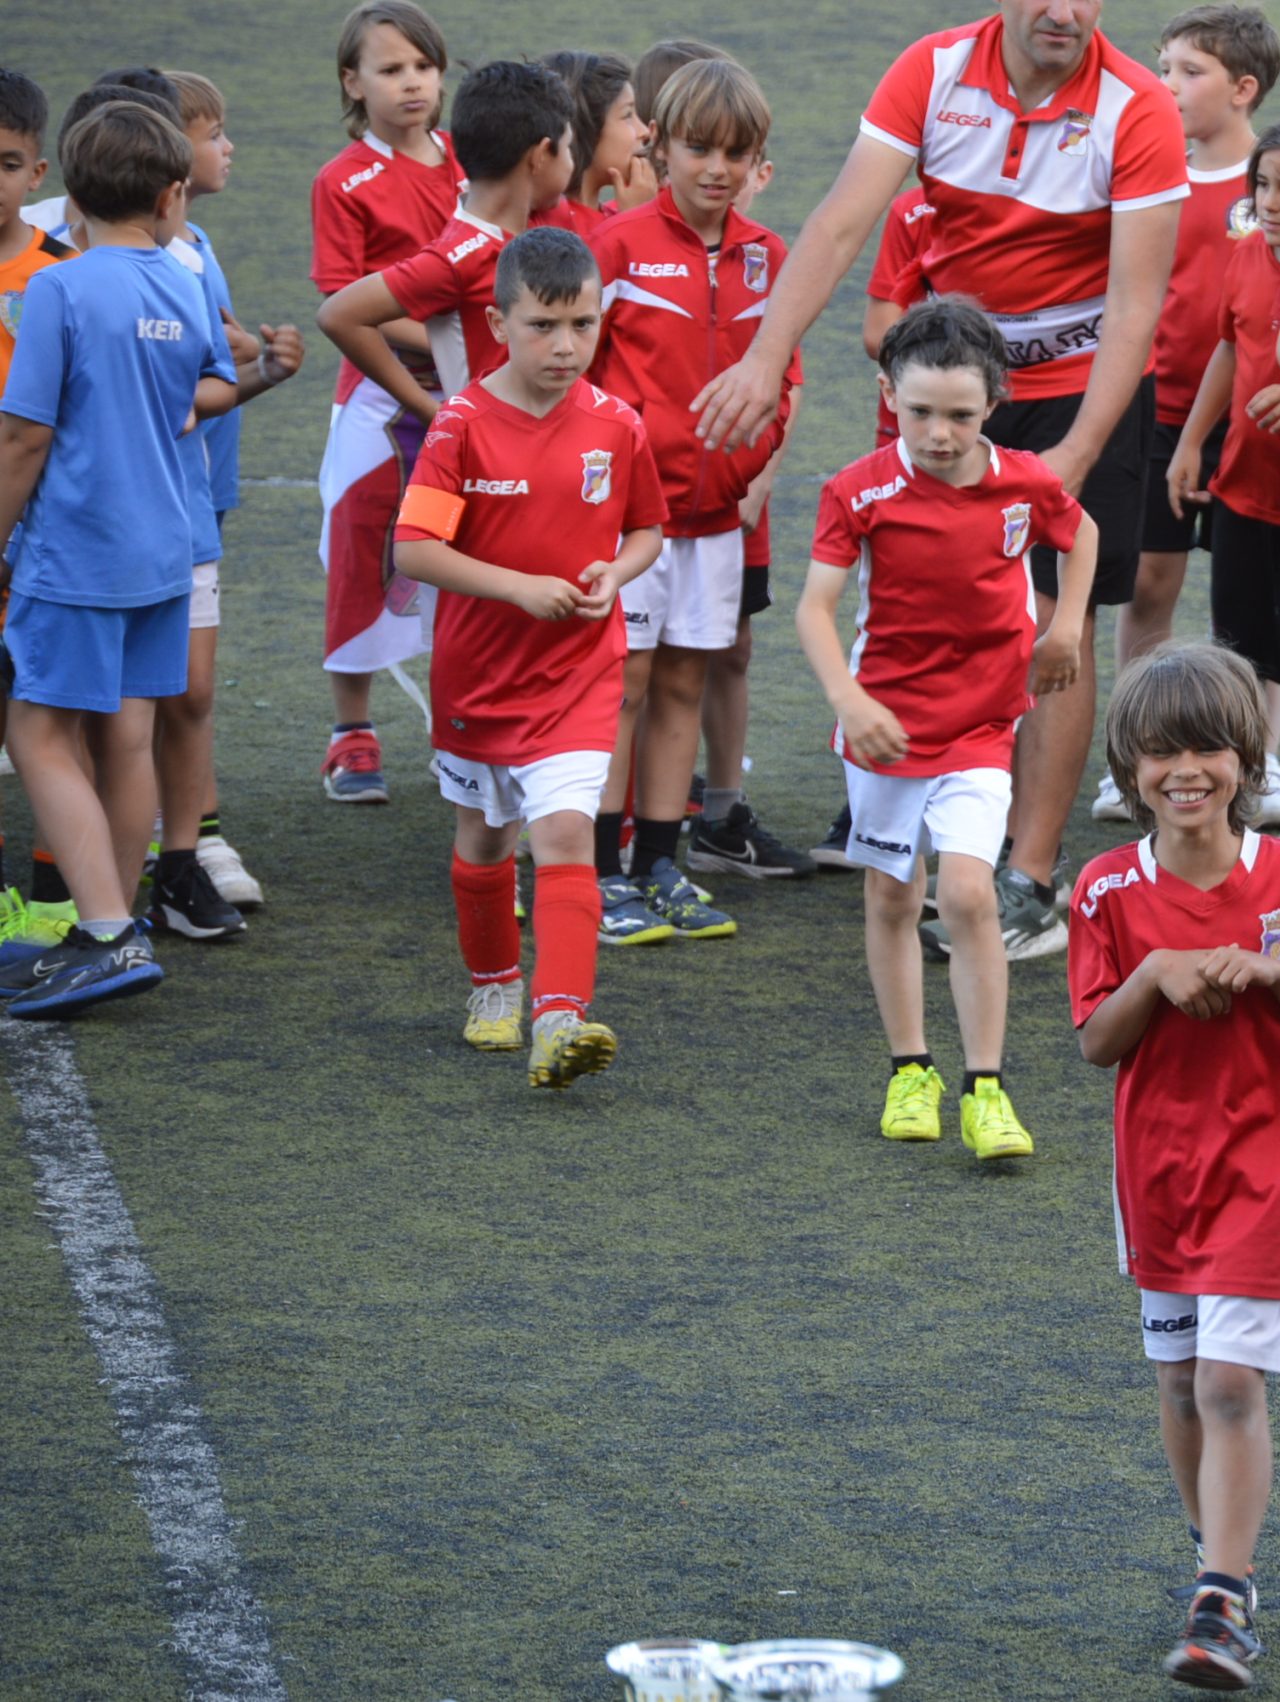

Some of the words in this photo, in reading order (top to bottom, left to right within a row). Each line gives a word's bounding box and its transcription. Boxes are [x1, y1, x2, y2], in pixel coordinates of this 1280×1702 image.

[936, 110, 992, 129] LEGEA
[341, 161, 386, 193] LEGEA
[447, 232, 490, 265] LEGEA
[628, 262, 690, 278] LEGEA
[462, 479, 530, 495] LEGEA
[851, 475, 907, 513] LEGEA
[437, 760, 480, 791] LEGEA
[856, 834, 912, 856] LEGEA
